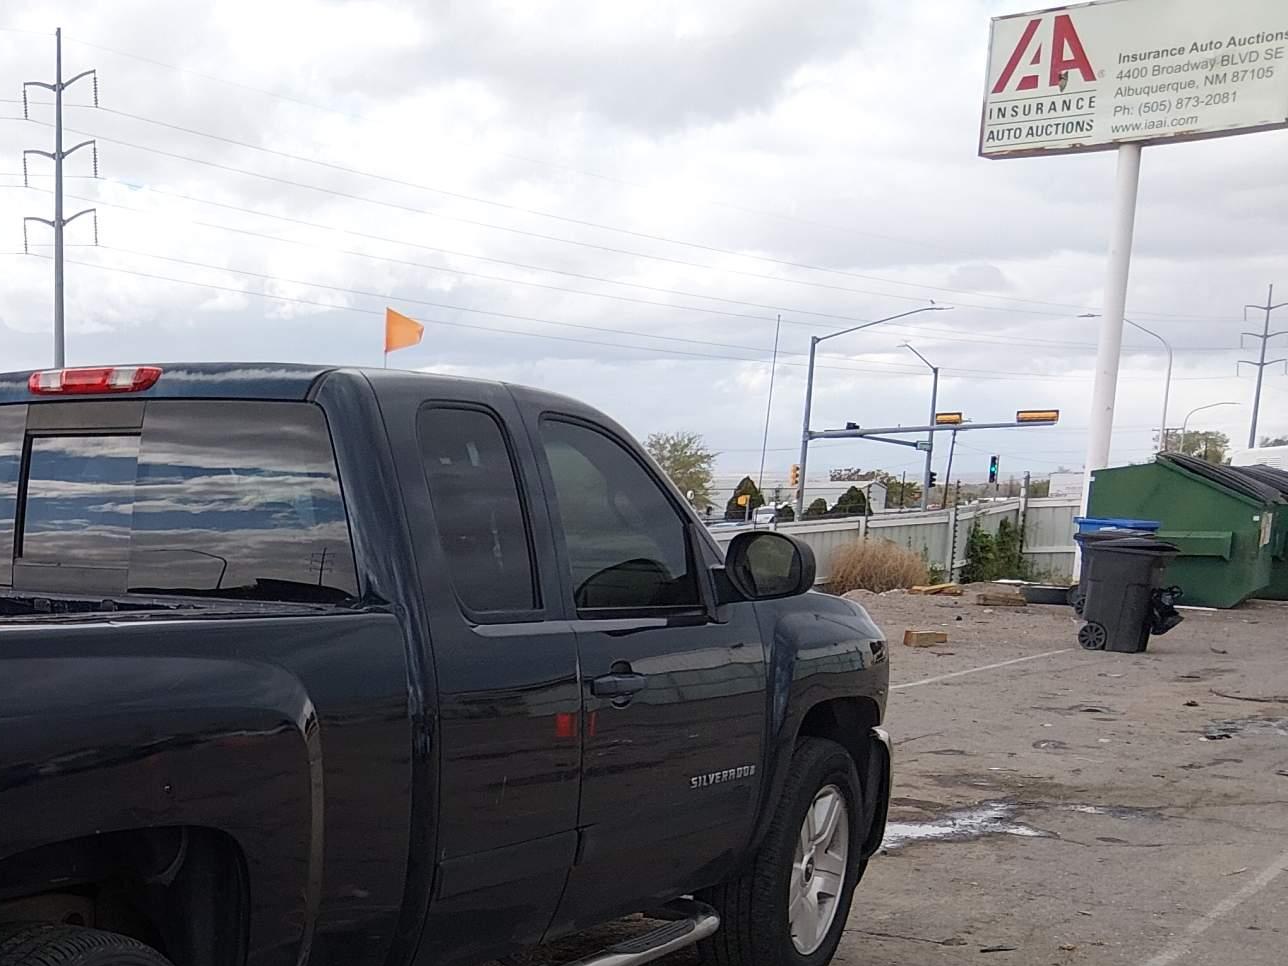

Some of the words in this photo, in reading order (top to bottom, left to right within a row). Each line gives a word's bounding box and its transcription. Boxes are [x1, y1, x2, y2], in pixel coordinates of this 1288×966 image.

[1116, 66, 1148, 81] 4400
[1151, 56, 1217, 77] Broadway
[1220, 50, 1260, 67] BLVD
[1263, 47, 1285, 61] SE
[1118, 46, 1185, 64] Insurance
[1189, 40, 1223, 54] Auto
[1114, 79, 1200, 98] Albuquerque,
[1203, 73, 1227, 87] NM
[1231, 66, 1274, 83] 87105
[989, 96, 1096, 120] INSURANCE
[1113, 105, 1135, 117] Ph:
[1138, 101, 1172, 117] (505)
[1175, 91, 1238, 110] 873-2081
[986, 127, 1023, 142] AUTO
[1025, 119, 1095, 138] AUCTIONS
[1111, 115, 1199, 134] www.iaai.com
